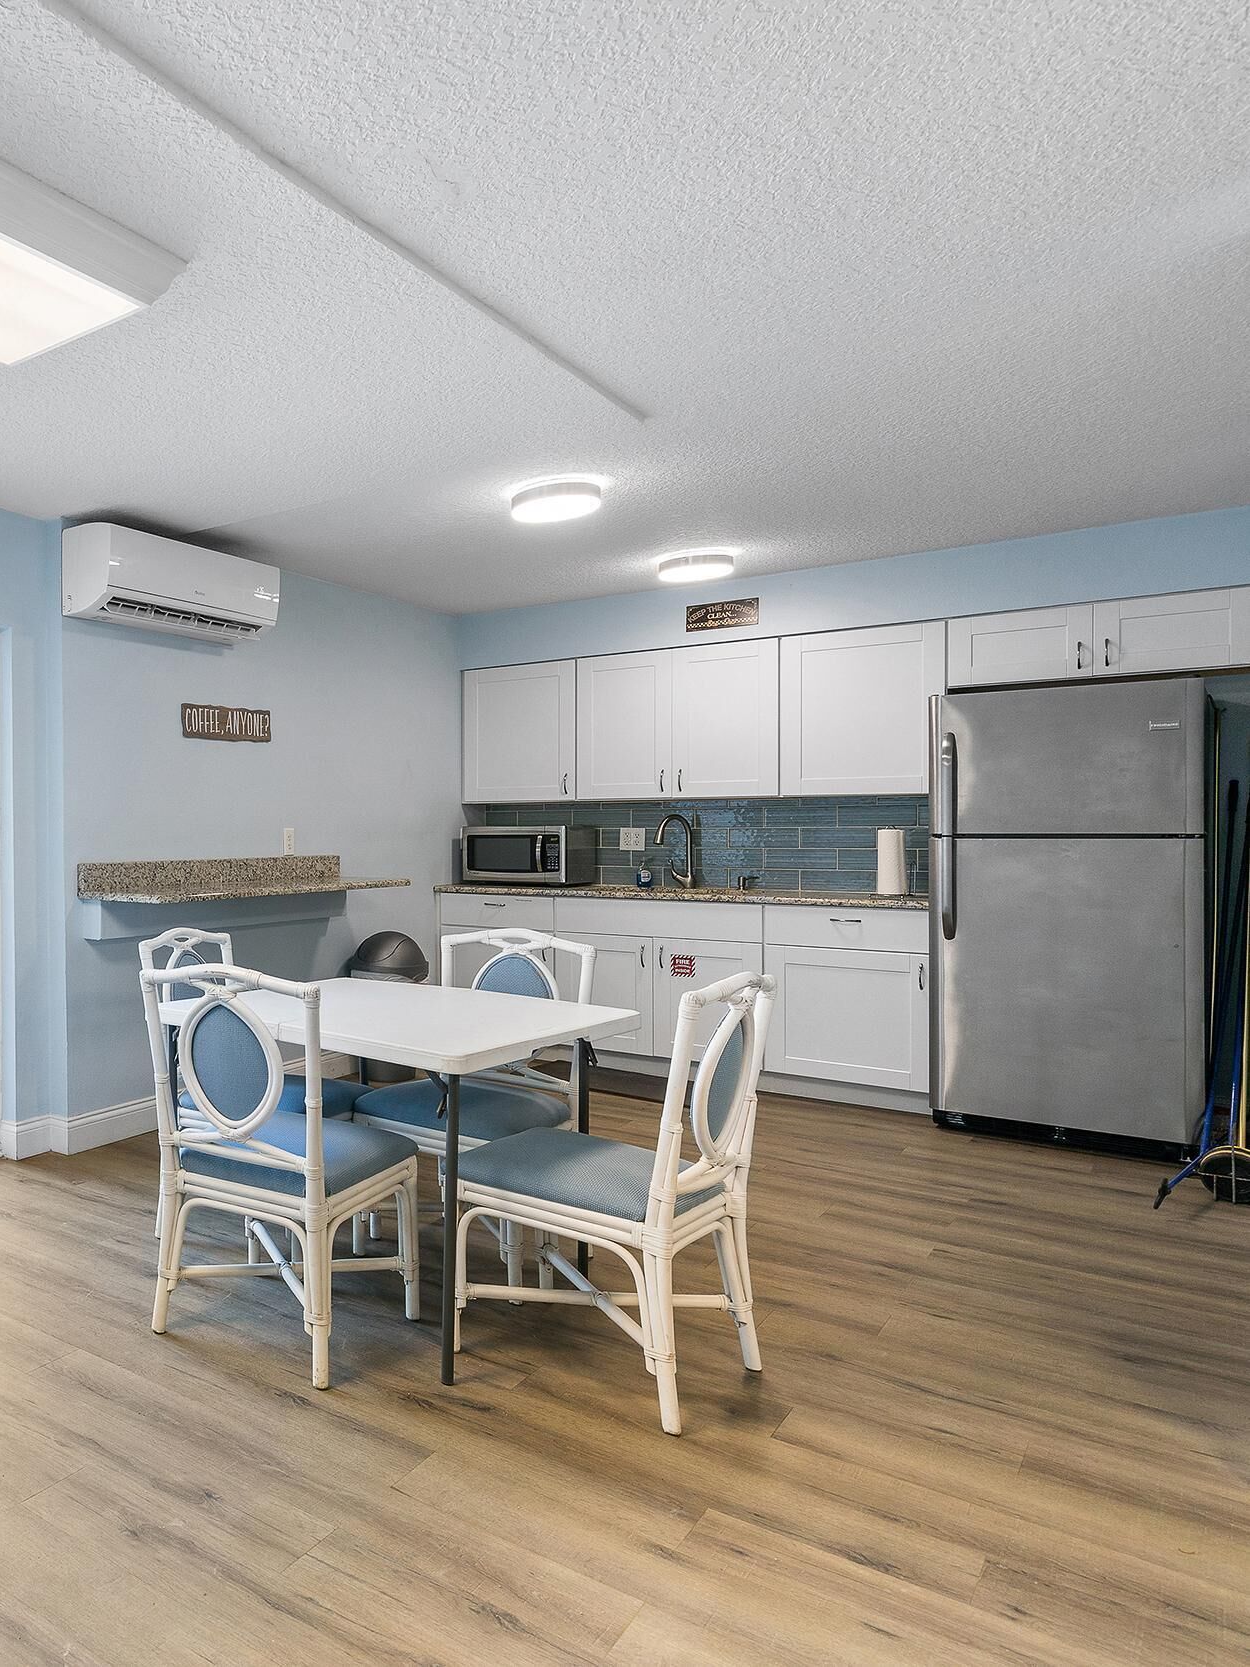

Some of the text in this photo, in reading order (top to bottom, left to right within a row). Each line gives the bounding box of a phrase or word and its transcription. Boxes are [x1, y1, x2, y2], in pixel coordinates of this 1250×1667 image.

[688, 603, 757, 623] KEEP THE KITCHEN
[185, 708, 269, 736] COFFEE, ANYONE?
